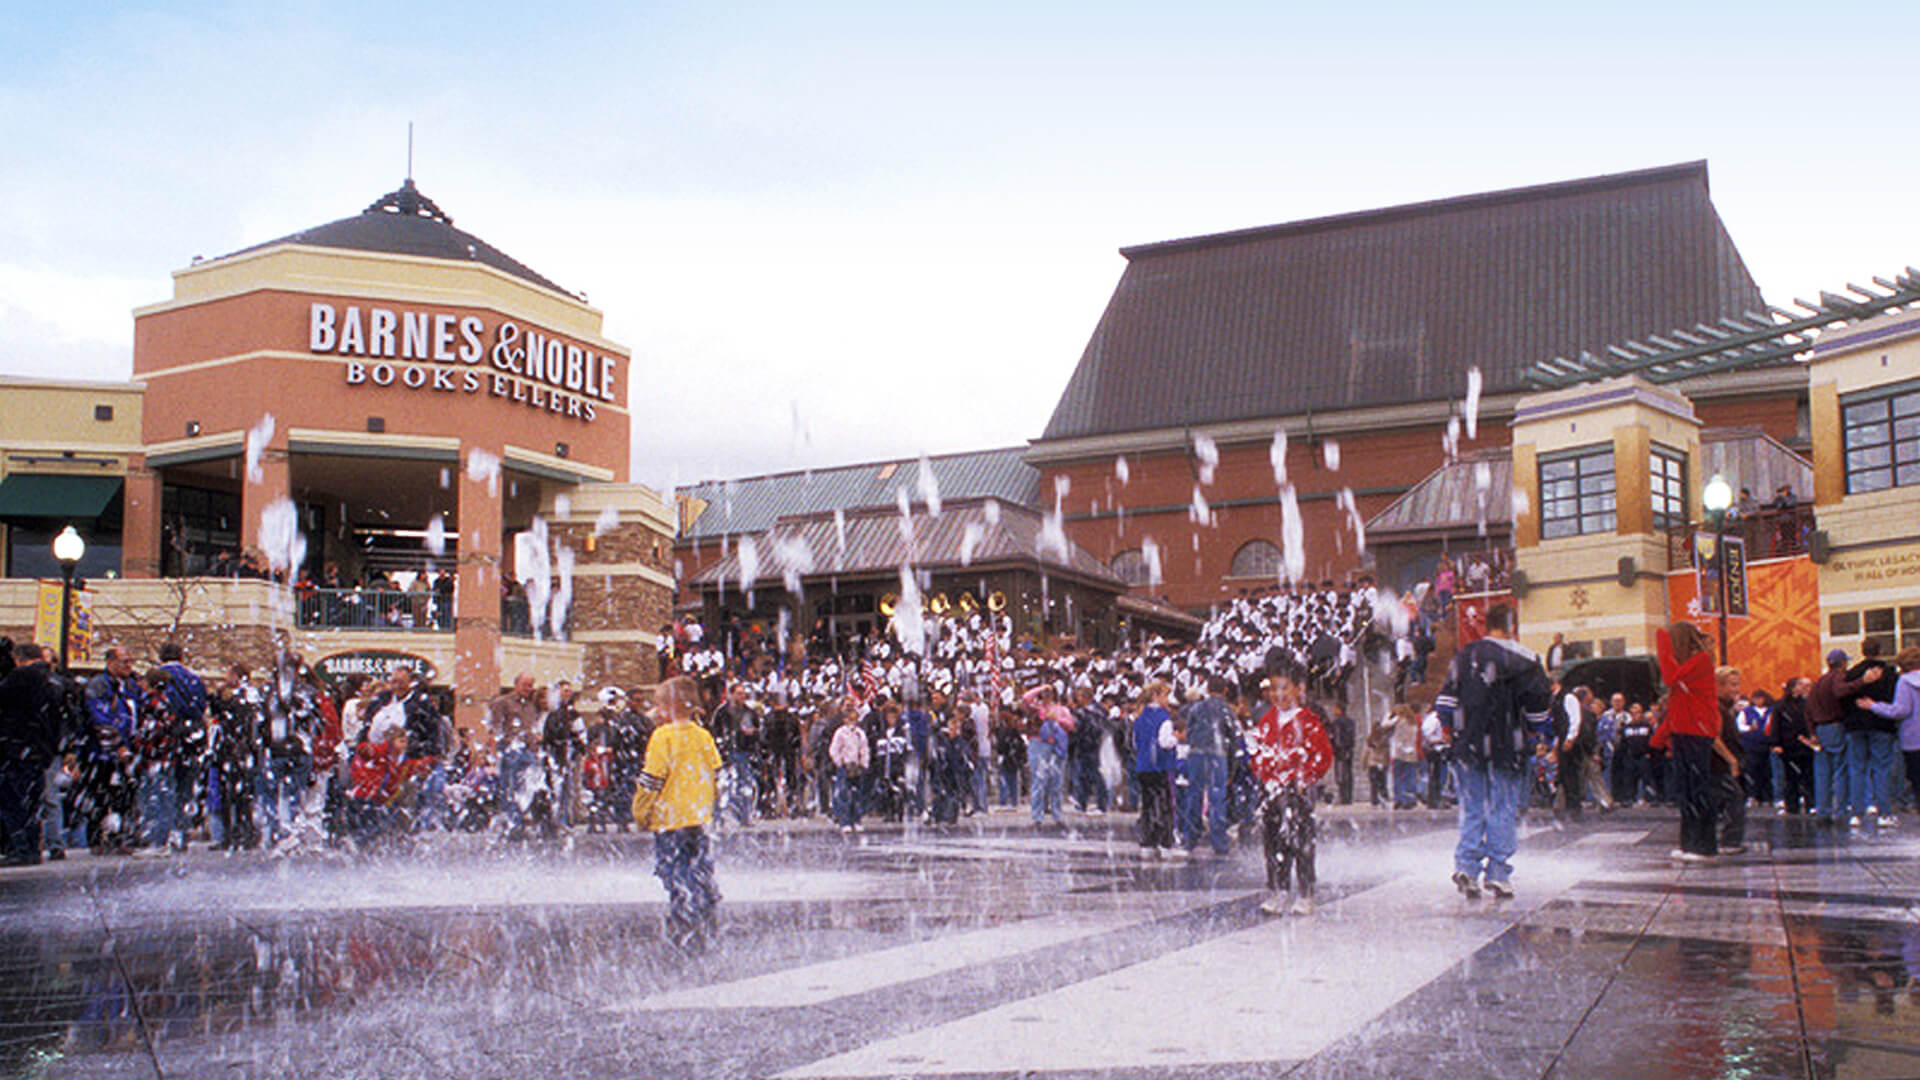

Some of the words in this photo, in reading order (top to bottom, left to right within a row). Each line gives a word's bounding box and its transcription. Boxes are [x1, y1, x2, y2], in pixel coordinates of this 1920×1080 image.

[310, 303, 484, 363] BARNES
[346, 362, 596, 422] BOOKSELLERS
[323, 658, 375, 674] BARNES
